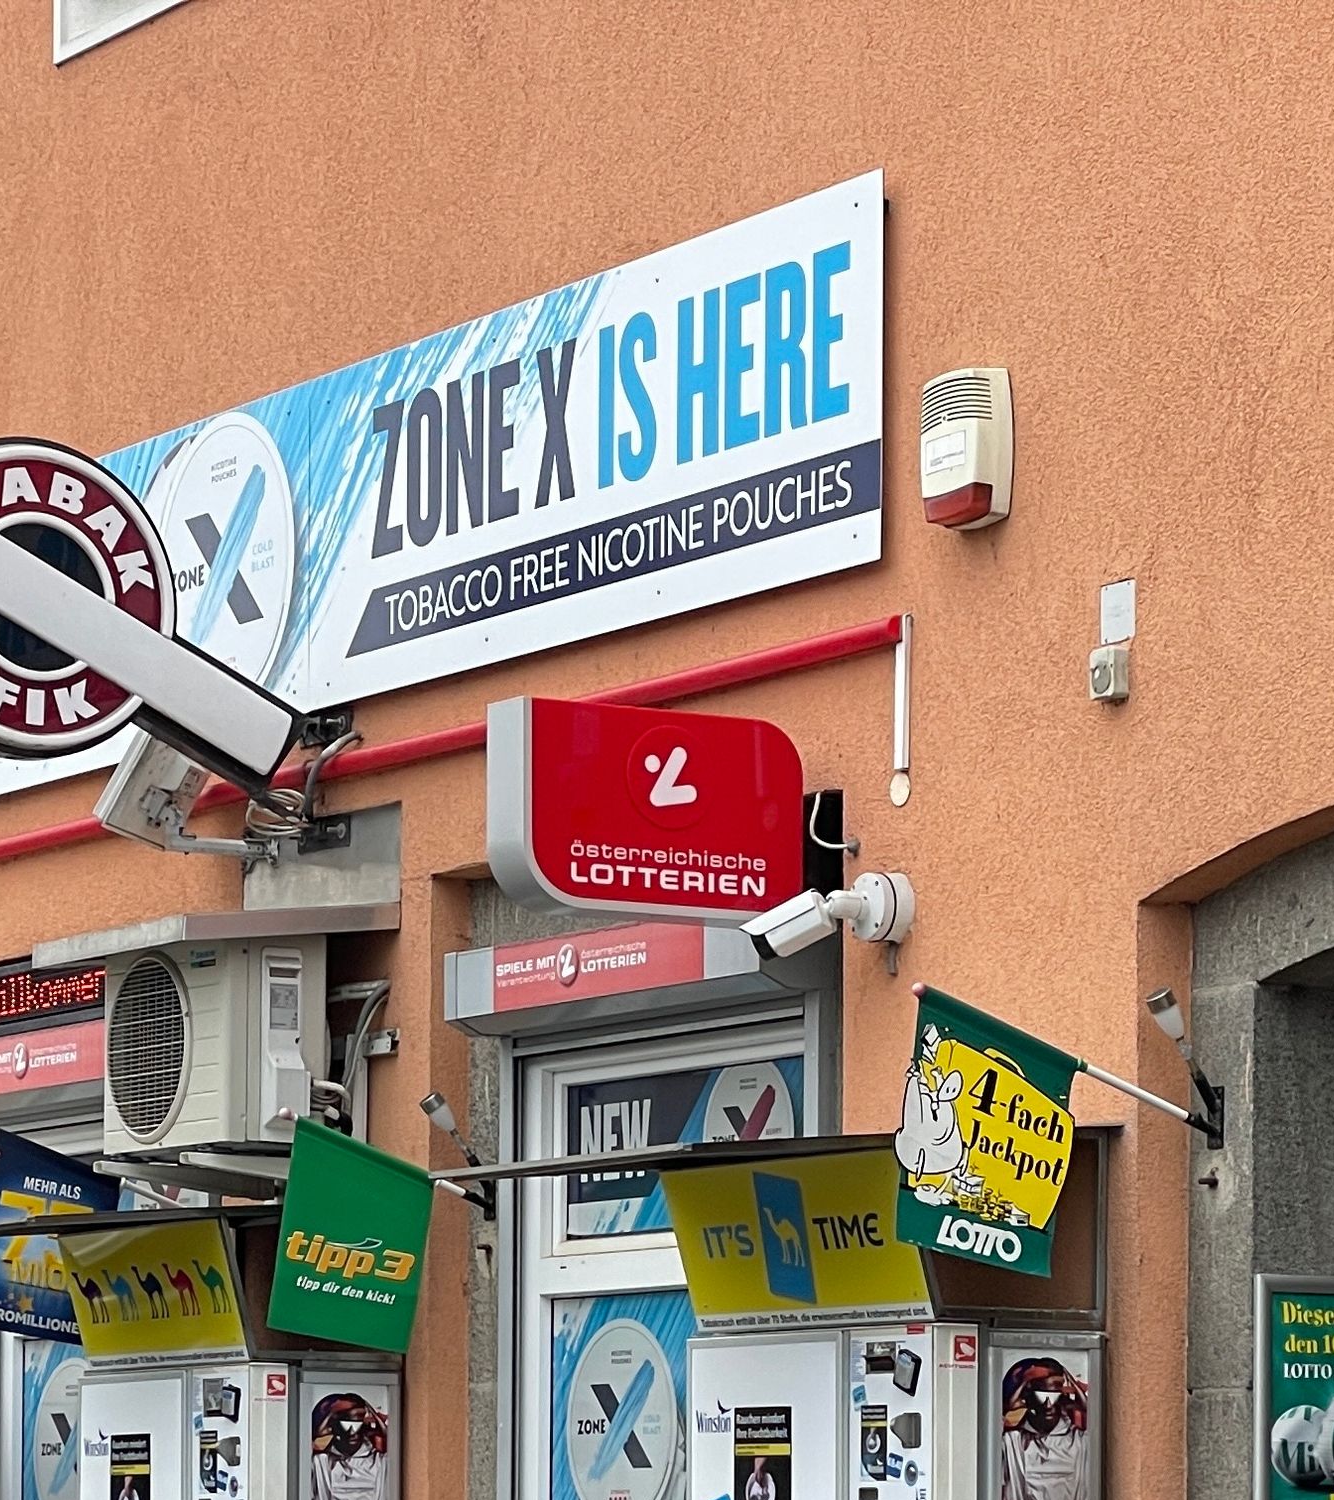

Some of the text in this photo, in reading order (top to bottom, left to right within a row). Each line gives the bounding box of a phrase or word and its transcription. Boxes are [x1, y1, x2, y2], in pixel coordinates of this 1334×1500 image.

[371, 240, 850, 559] ZONE X IS HERE
[252, 539, 274, 556] COLD
[385, 460, 854, 635] TOBACCO FREE NICOTINE POUCHES
[251, 556, 274, 573] BLAST
[570, 839, 767, 872] österreichische
[570, 862, 766, 898] LOTTERIEN
[496, 955, 556, 977] SPIELE MIT
[580, 952, 647, 973] LOTTERIEN
[29, 1051, 77, 1068] LOTTERIEN
[967, 1067, 1065, 1146] 4-fach
[964, 1124, 1066, 1190] Jackpot
[23, 1176, 82, 1201] MEHR ALS
[702, 1212, 884, 1259] IT'S TIME
[937, 1215, 1022, 1263] LOTTO
[296, 1274, 396, 1305] tipp dir den kick!
[1284, 1334, 1318, 1354] den
[1283, 1363, 1332, 1379] LOTTO
[577, 1419, 606, 1435] ZONE
[695, 1409, 732, 1434] Winston
[41, 1442, 62, 1457] ZONE
[84, 1438, 109, 1457] Winston
